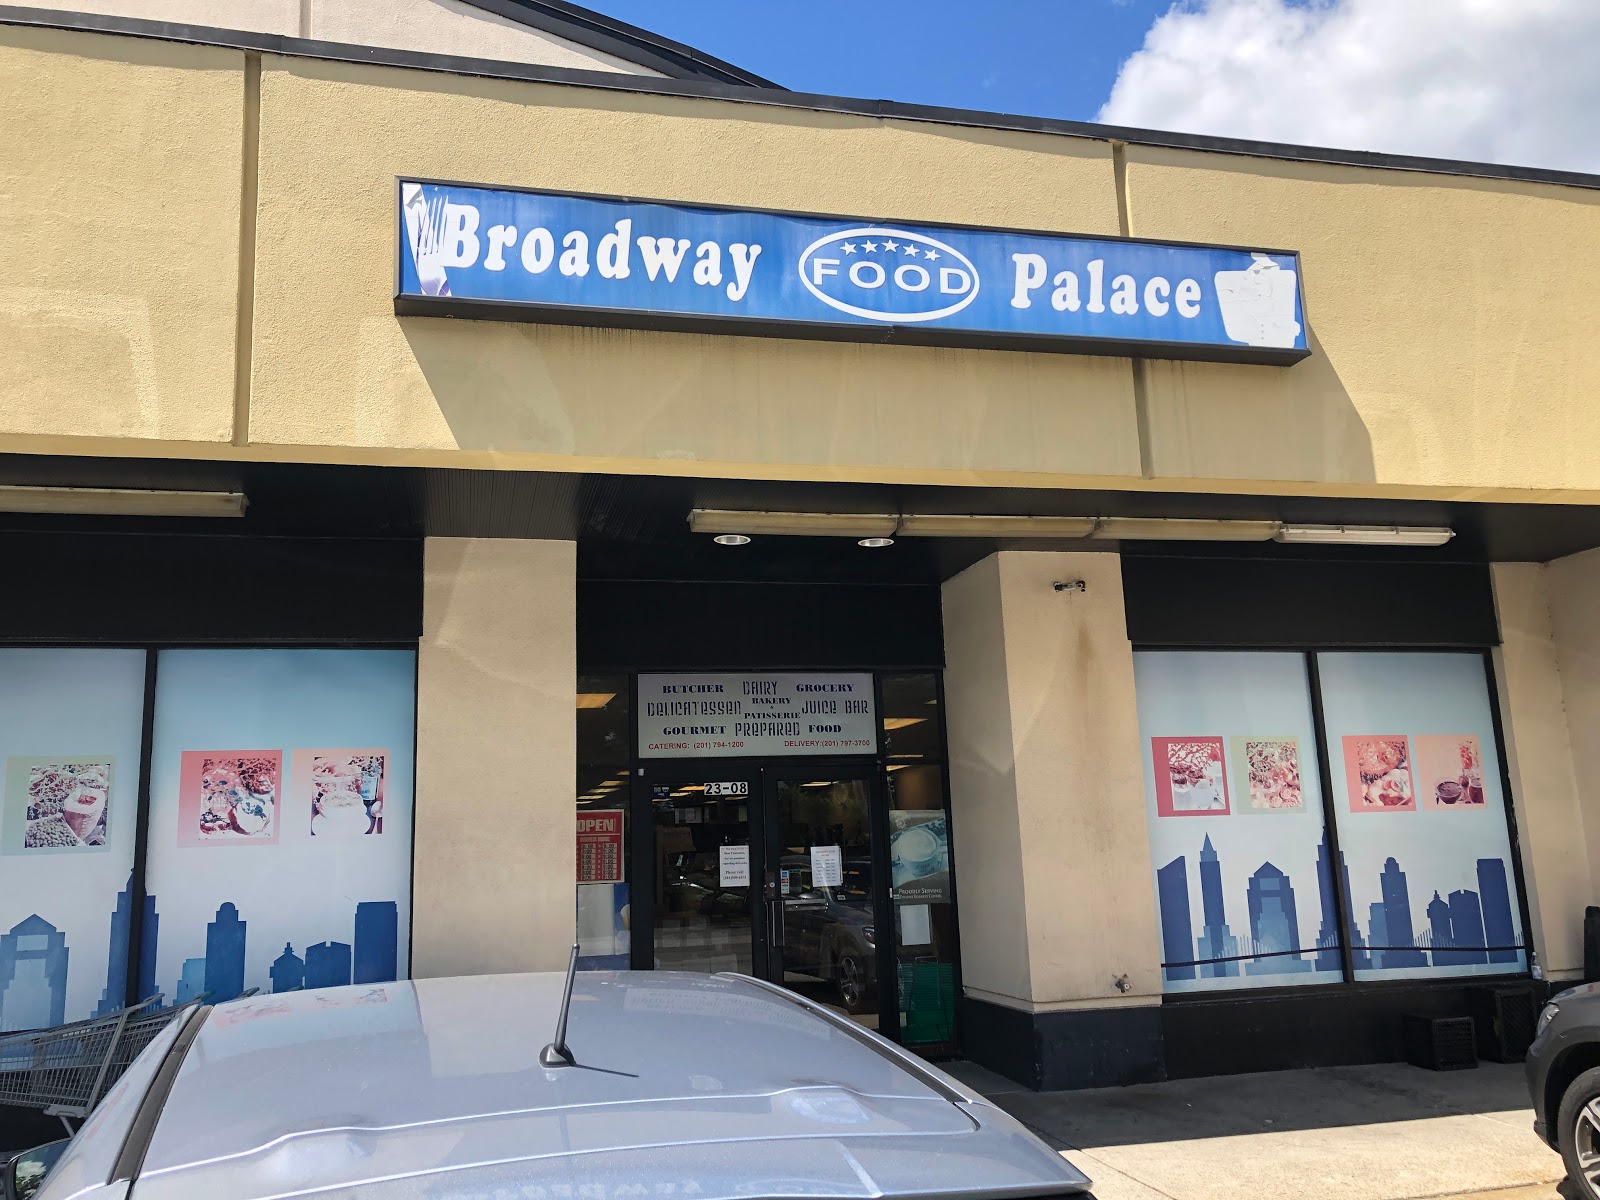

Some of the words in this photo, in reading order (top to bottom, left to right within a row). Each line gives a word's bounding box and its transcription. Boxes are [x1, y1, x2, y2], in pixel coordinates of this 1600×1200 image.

[441, 203, 762, 302] Broadway
[812, 258, 972, 294] FOOD
[1010, 252, 1202, 319] Palace
[662, 684, 724, 694] BUTCHER
[742, 681, 778, 695] DAIRY
[796, 683, 855, 693] GROCERY
[751, 697, 792, 705] BAKERY
[801, 700, 837, 714] JUICE
[845, 700, 869, 714] BAR
[647, 701, 741, 717] DELICATESSEN
[744, 712, 801, 720] PATISSERIE
[663, 725, 727, 736] GOURMET
[735, 722, 800, 737] PREPARED
[808, 724, 842, 733] FOOD
[648, 742, 690, 750] CATERING:
[693, 741, 711, 750] (201)
[713, 741, 744, 749] 794-1200
[840, 739, 870, 747] 797-3700
[705, 782, 747, 795] 23-08
[576, 818, 614, 832] OPEN
